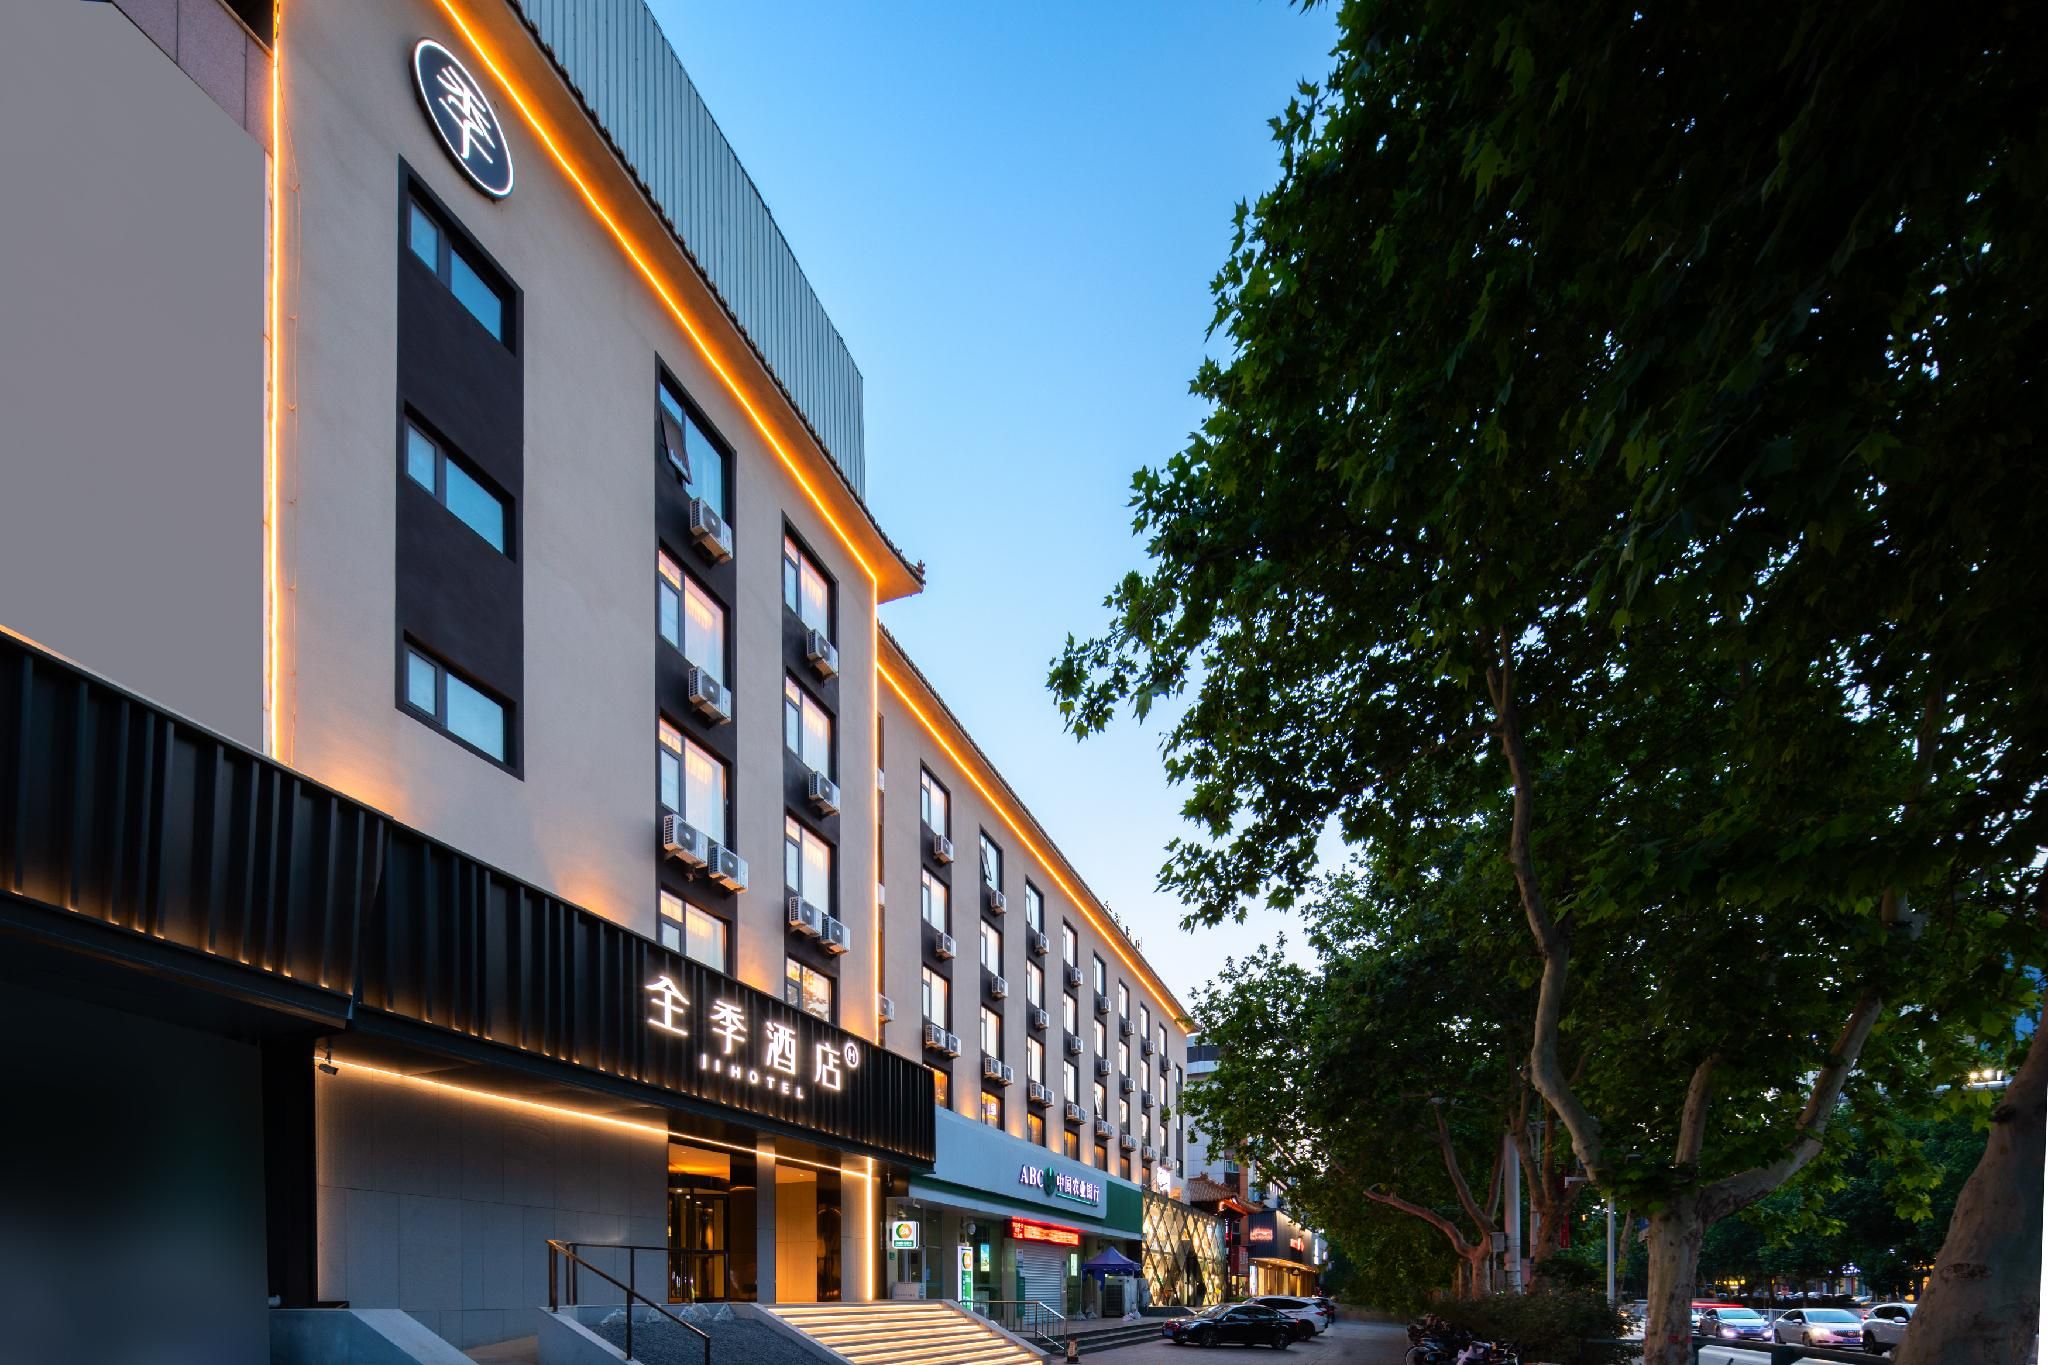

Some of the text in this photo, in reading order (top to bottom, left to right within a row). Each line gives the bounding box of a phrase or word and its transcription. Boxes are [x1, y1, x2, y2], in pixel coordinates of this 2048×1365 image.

[644, 974, 842, 1092] 全季酒店
[1019, 1164, 1044, 1188] ABC
[1055, 1172, 1100, 1203] 中国农业银行
